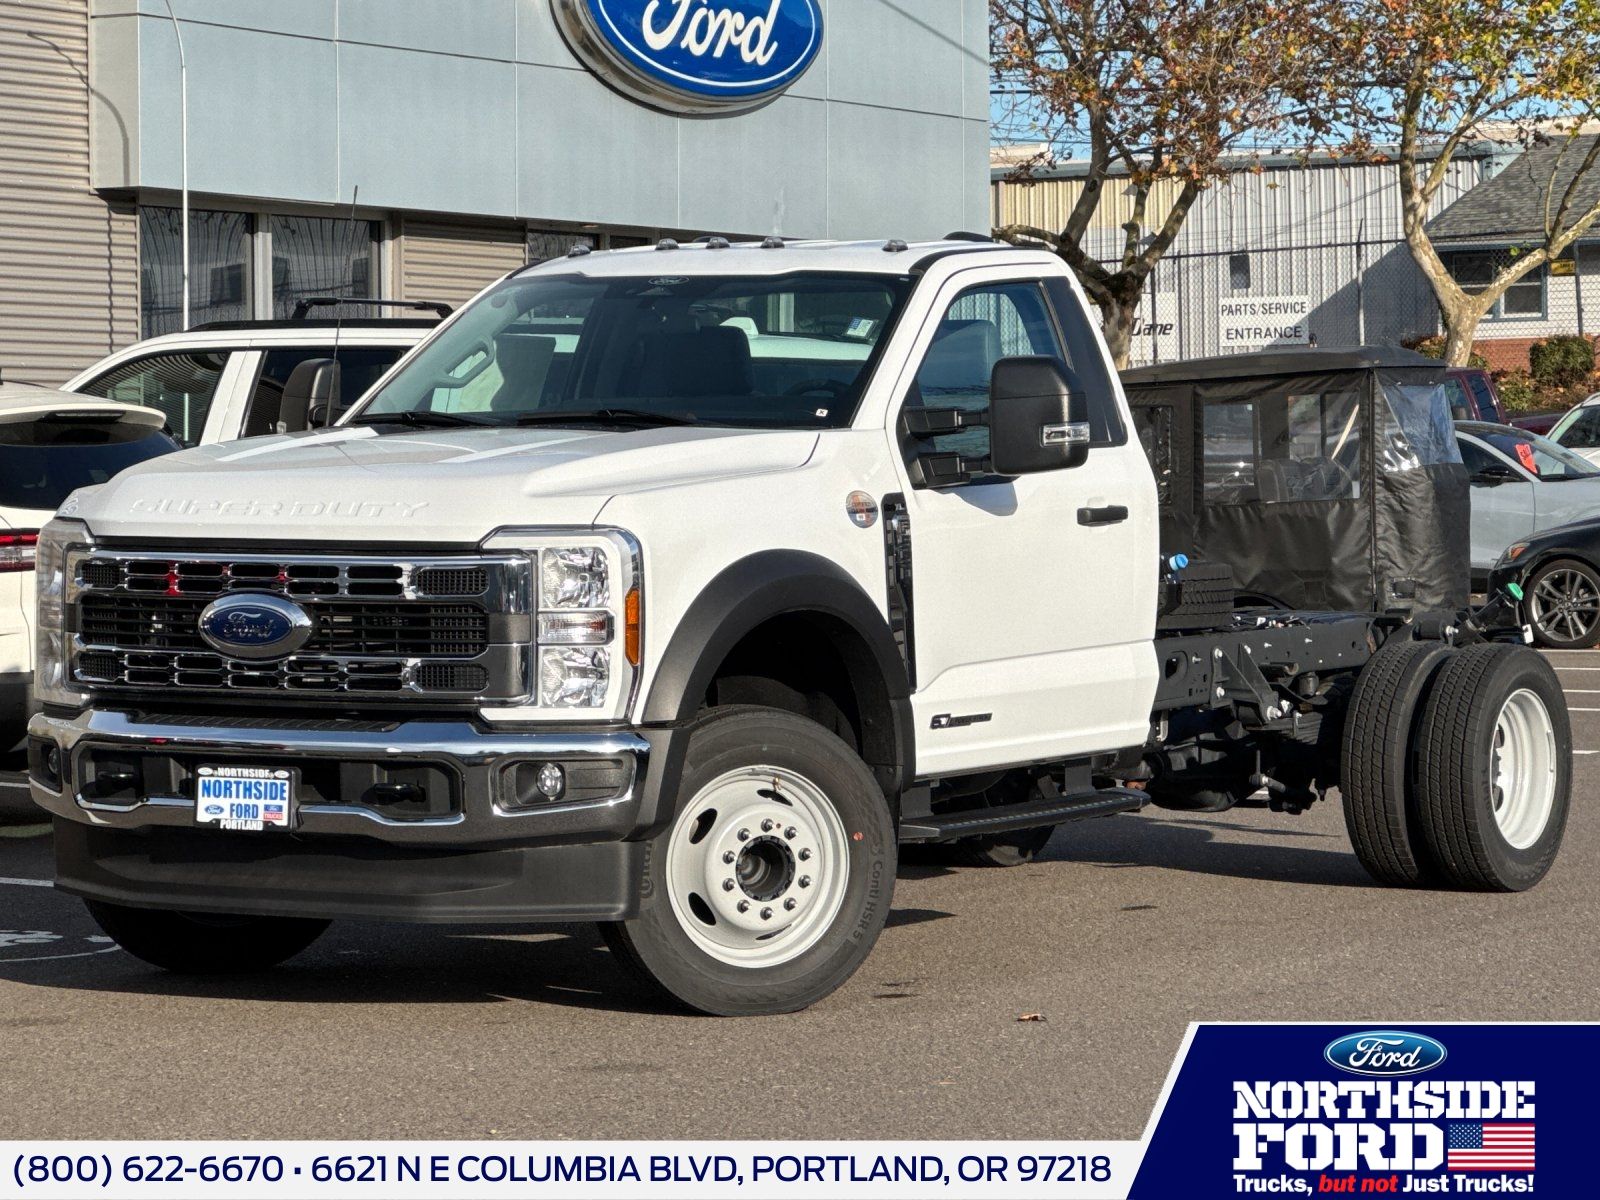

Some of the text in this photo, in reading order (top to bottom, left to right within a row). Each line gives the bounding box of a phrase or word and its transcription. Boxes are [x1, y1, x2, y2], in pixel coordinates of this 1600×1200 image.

[1221, 301, 1307, 316] PARTS/SERVICE
[1132, 318, 1174, 336] Dane
[1226, 325, 1303, 340] ENTRANCE
[289, 500, 430, 518] DUTY
[217, 767, 270, 778] NORTHSIDE
[201, 779, 287, 801] NORTHSIDE
[229, 803, 259, 819] FORD
[219, 820, 264, 831] PORTLAND
